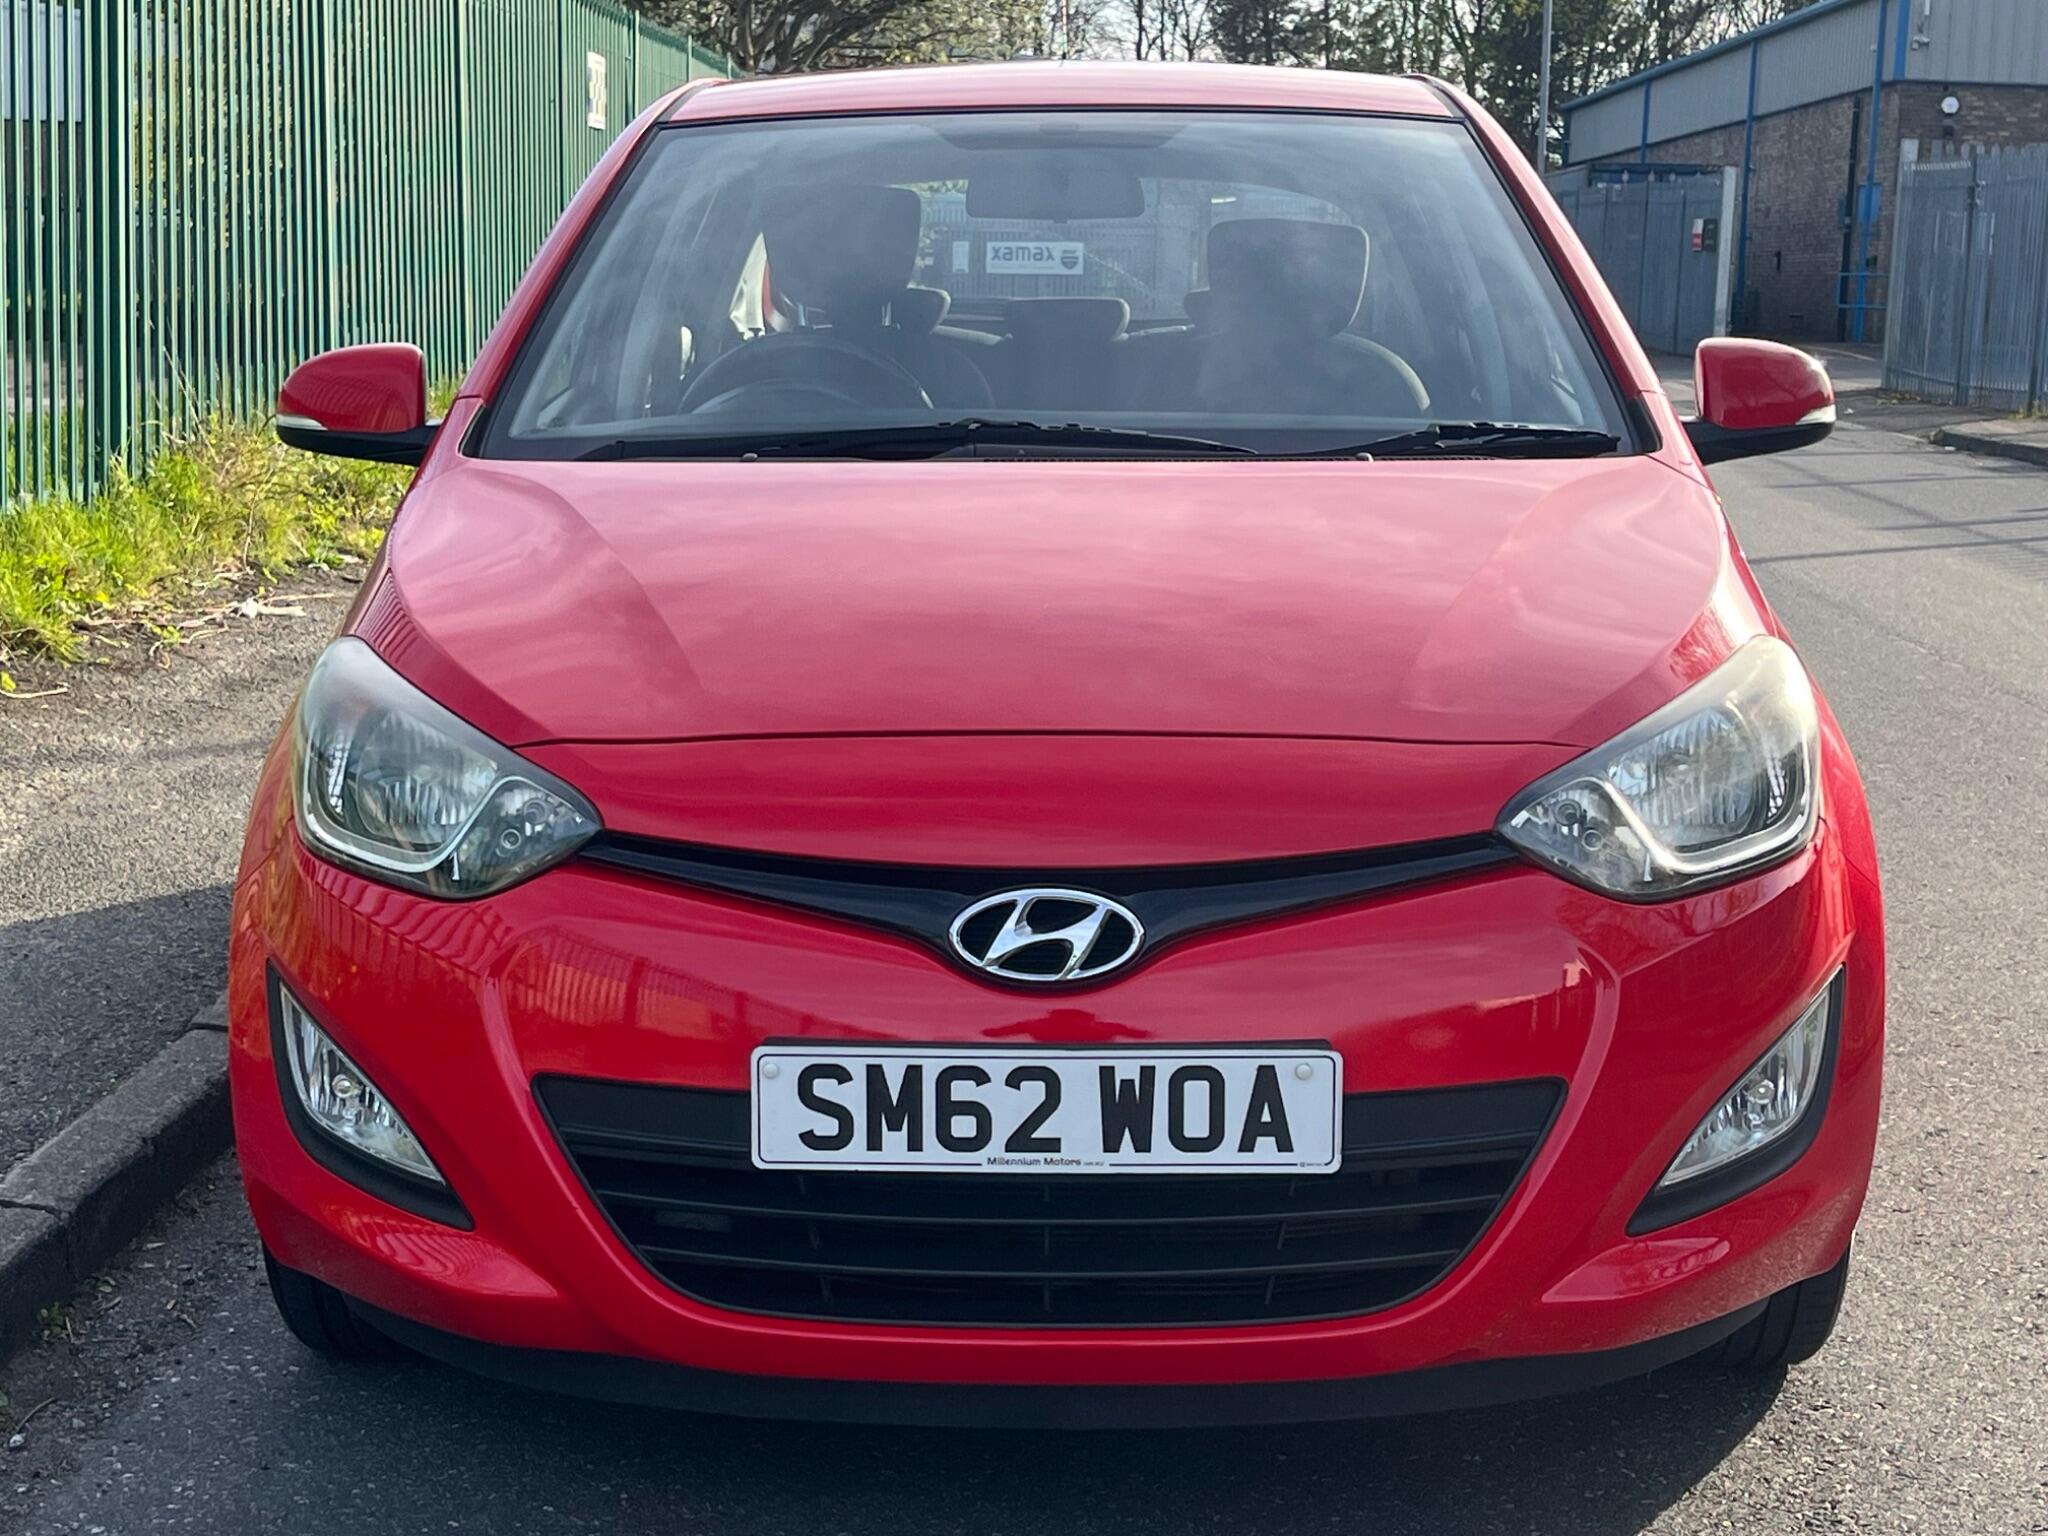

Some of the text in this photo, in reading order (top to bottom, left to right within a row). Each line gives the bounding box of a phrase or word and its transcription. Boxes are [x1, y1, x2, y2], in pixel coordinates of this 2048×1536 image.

[991, 246, 1055, 262] xamax
[797, 1063, 1294, 1153] SM62 WOA
[986, 1156, 1041, 1166] Millennium
[1043, 1156, 1081, 1166] Motors
